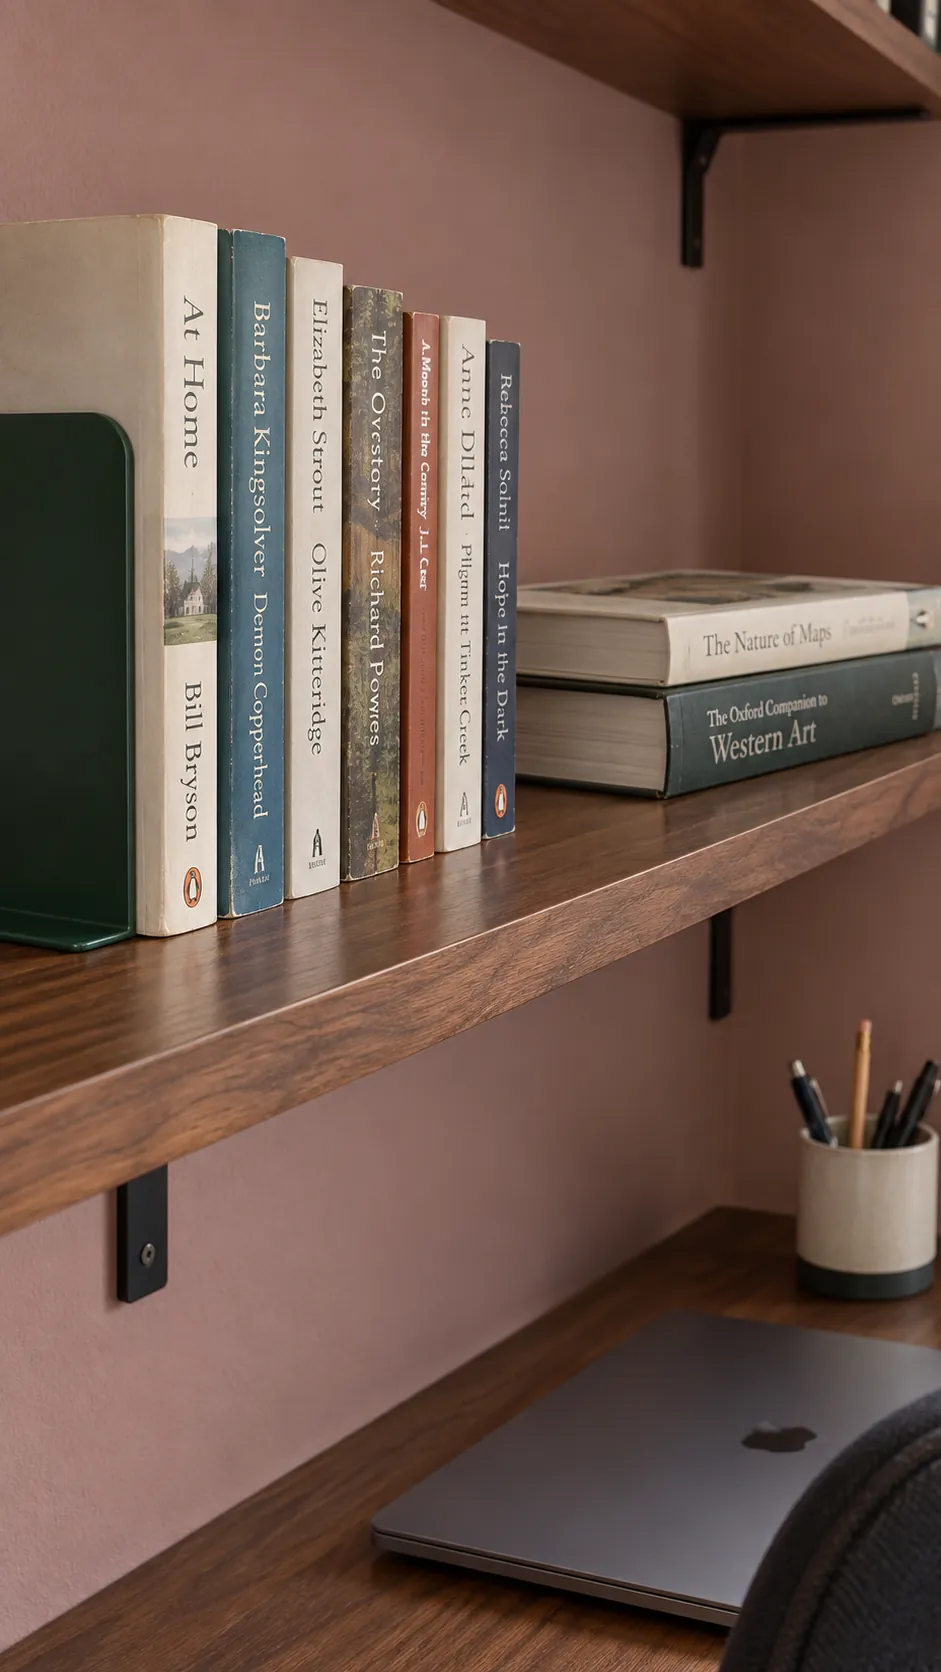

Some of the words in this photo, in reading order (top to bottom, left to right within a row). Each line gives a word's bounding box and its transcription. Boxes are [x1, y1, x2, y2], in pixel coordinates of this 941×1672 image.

[184, 295, 204, 341] At
[371, 330, 386, 380] The
[253, 301, 271, 416] Barbara
[312, 299, 328, 421] Elizabeth
[184, 356, 205, 469] Home
[248, 427, 271, 577] Kingsolver
[312, 430, 327, 513] Strout
[311, 539, 327, 613] Olive
[369, 551, 385, 649] Richard
[253, 592, 268, 676] Demon
[497, 653, 508, 683] the
[703, 633, 730, 656] The
[735, 630, 779, 653] Nature
[783, 624, 797, 646] of
[799, 623, 832, 647] Maps
[185, 681, 203, 731] Bill
[308, 624, 327, 756] Kitteridge
[497, 690, 508, 741] Dark
[707, 709, 727, 727] The
[730, 702, 764, 723] Oxford
[766, 693, 816, 717] Companion
[819, 694, 828, 706] to
[248, 682, 268, 820] Copperhead
[459, 710, 470, 765] Creek
[710, 730, 782, 764] Western
[788, 719, 816, 747] Art
[180, 741, 202, 842] Bryson
